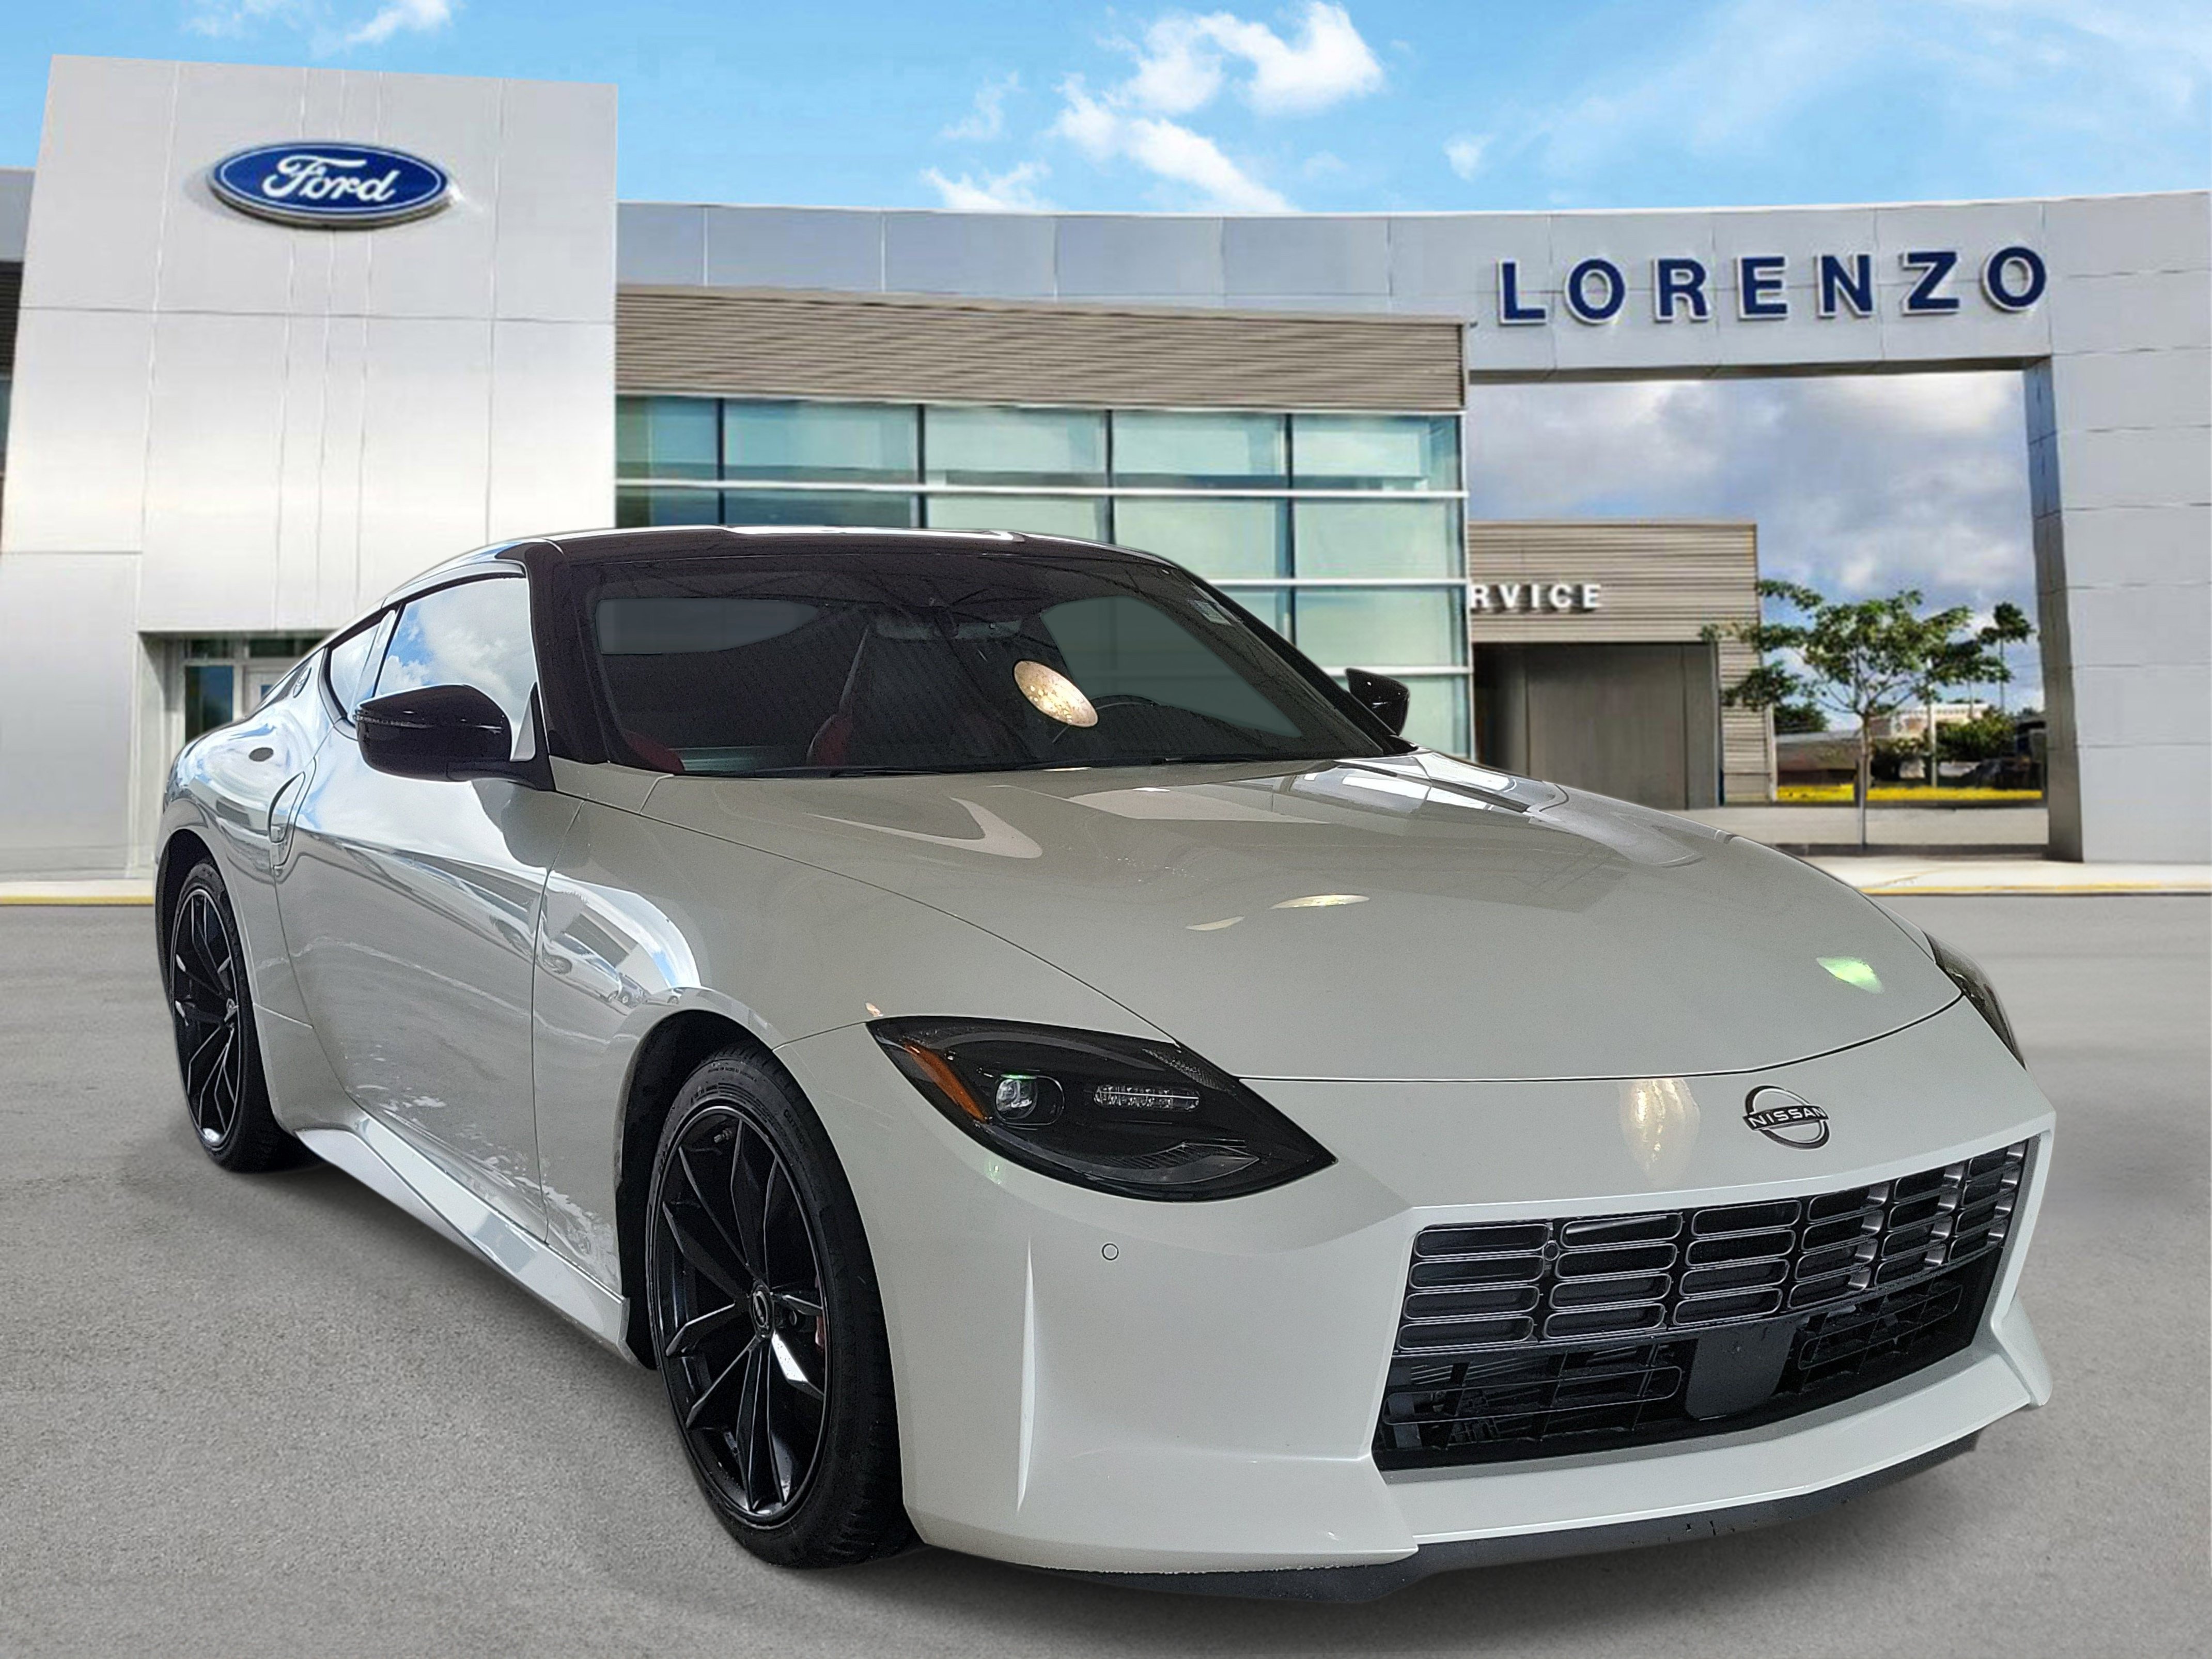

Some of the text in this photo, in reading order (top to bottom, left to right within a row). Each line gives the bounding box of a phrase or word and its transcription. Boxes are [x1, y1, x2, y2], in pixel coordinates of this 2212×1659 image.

[262, 154, 400, 201] Ford
[1497, 245, 2047, 324] LORENZO
[1748, 1107, 1826, 1127] NISSAN
